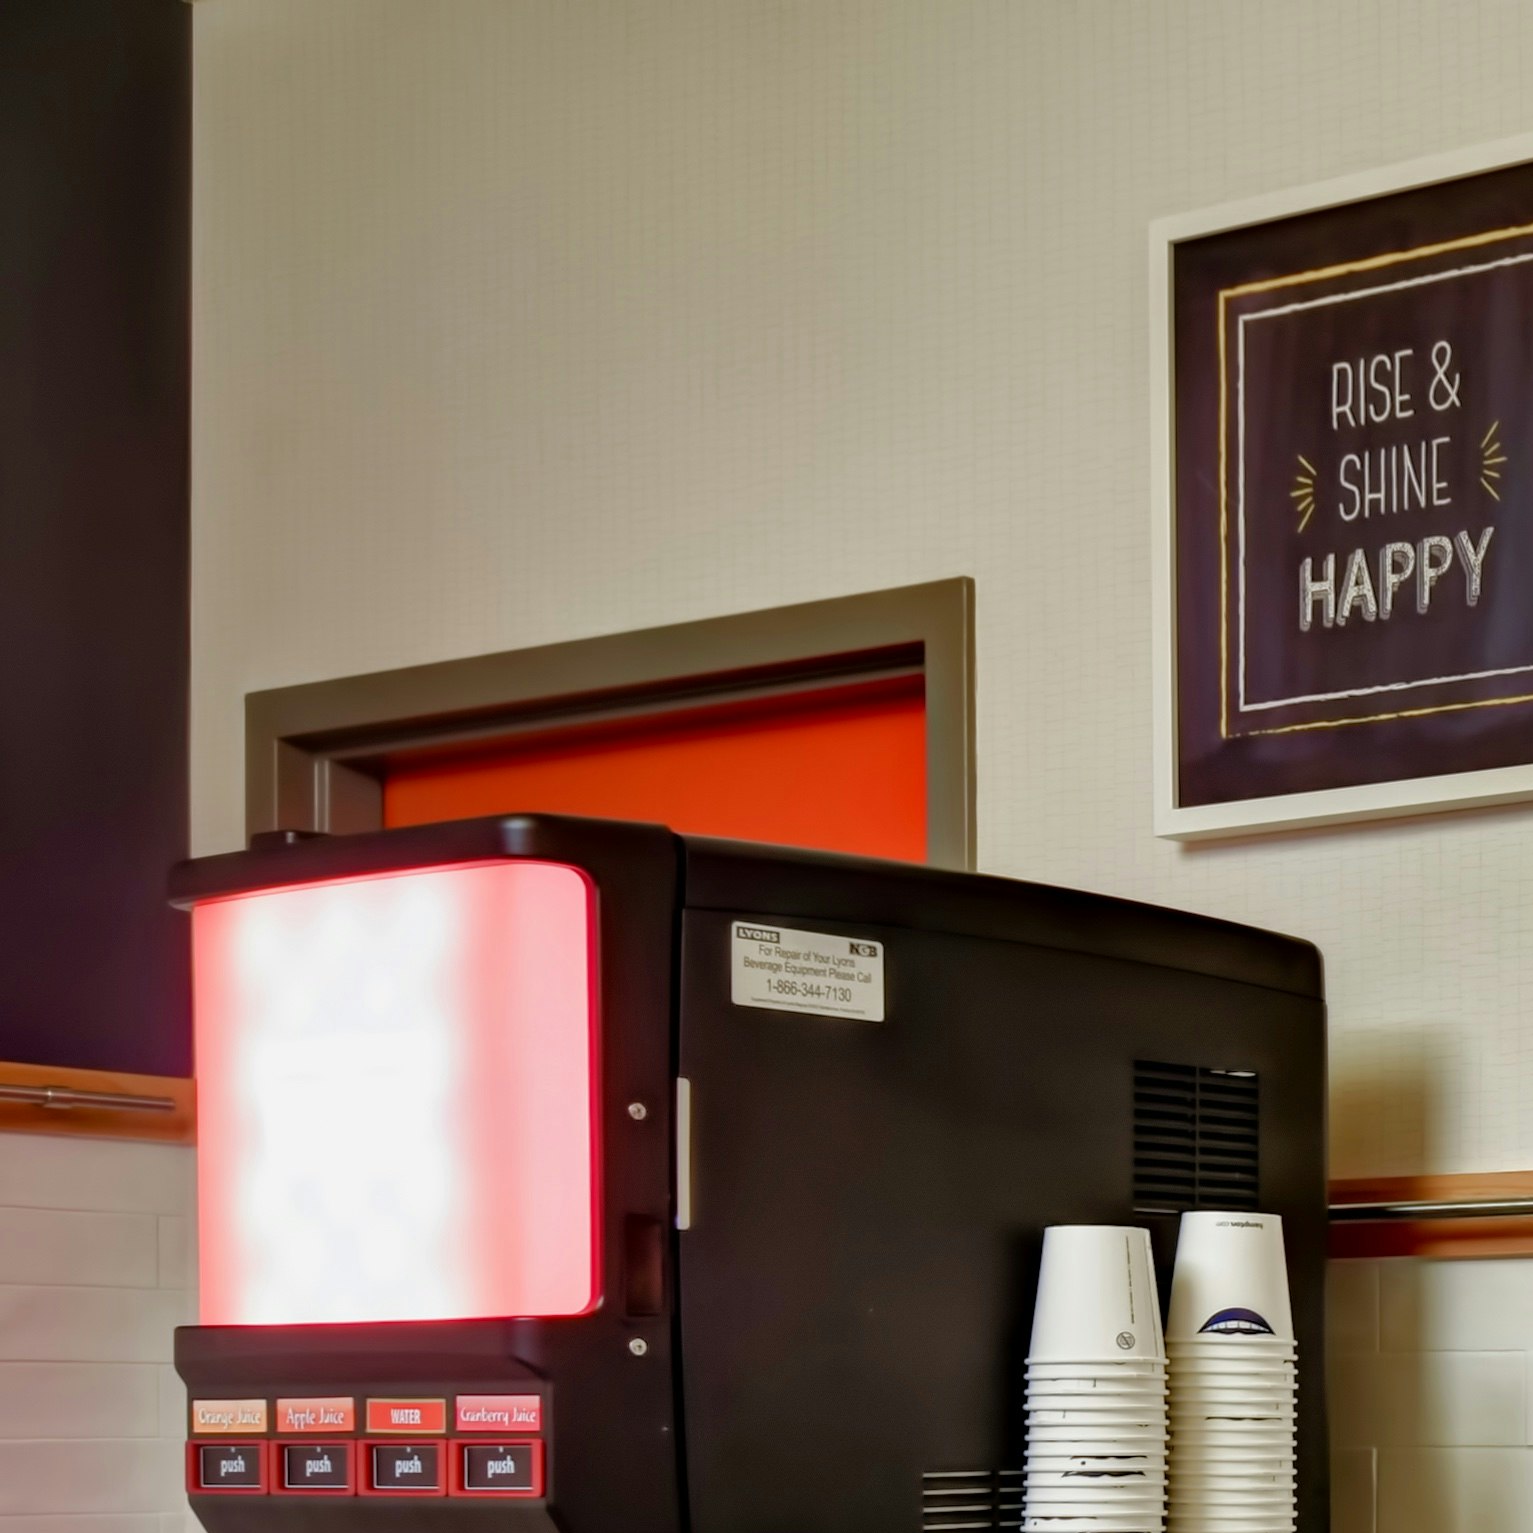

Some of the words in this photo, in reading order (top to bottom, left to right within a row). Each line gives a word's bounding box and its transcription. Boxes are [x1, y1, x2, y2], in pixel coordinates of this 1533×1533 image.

[1331, 349, 1414, 430] RISE
[1428, 340, 1462, 411] &
[1338, 436, 1452, 521] SHINE
[1300, 526, 1495, 631] HAPPY
[738, 928, 778, 943] LYONS
[759, 944, 773, 957] For
[774, 947, 801, 961] Repair
[802, 950, 812, 962] of
[813, 952, 831, 964] Your
[832, 954, 856, 969] Lyons
[743, 956, 783, 974] Beverage
[784, 962, 827, 979] Equipment
[828, 968, 856, 982] Please
[857, 972, 873, 985] Call
[766, 978, 853, 1003] 1-866-344-7130
[199, 1407, 234, 1430] Orange
[235, 1407, 261, 1425] Juice
[286, 1407, 316, 1430] Apple
[319, 1407, 345, 1425] Juice
[390, 1408, 421, 1425] WATER
[460, 1406, 508, 1427] Cranberry
[511, 1407, 537, 1424] Juice
[220, 1454, 246, 1477] push
[305, 1454, 332, 1477] push
[394, 1454, 422, 1478] push
[486, 1454, 516, 1478] push
